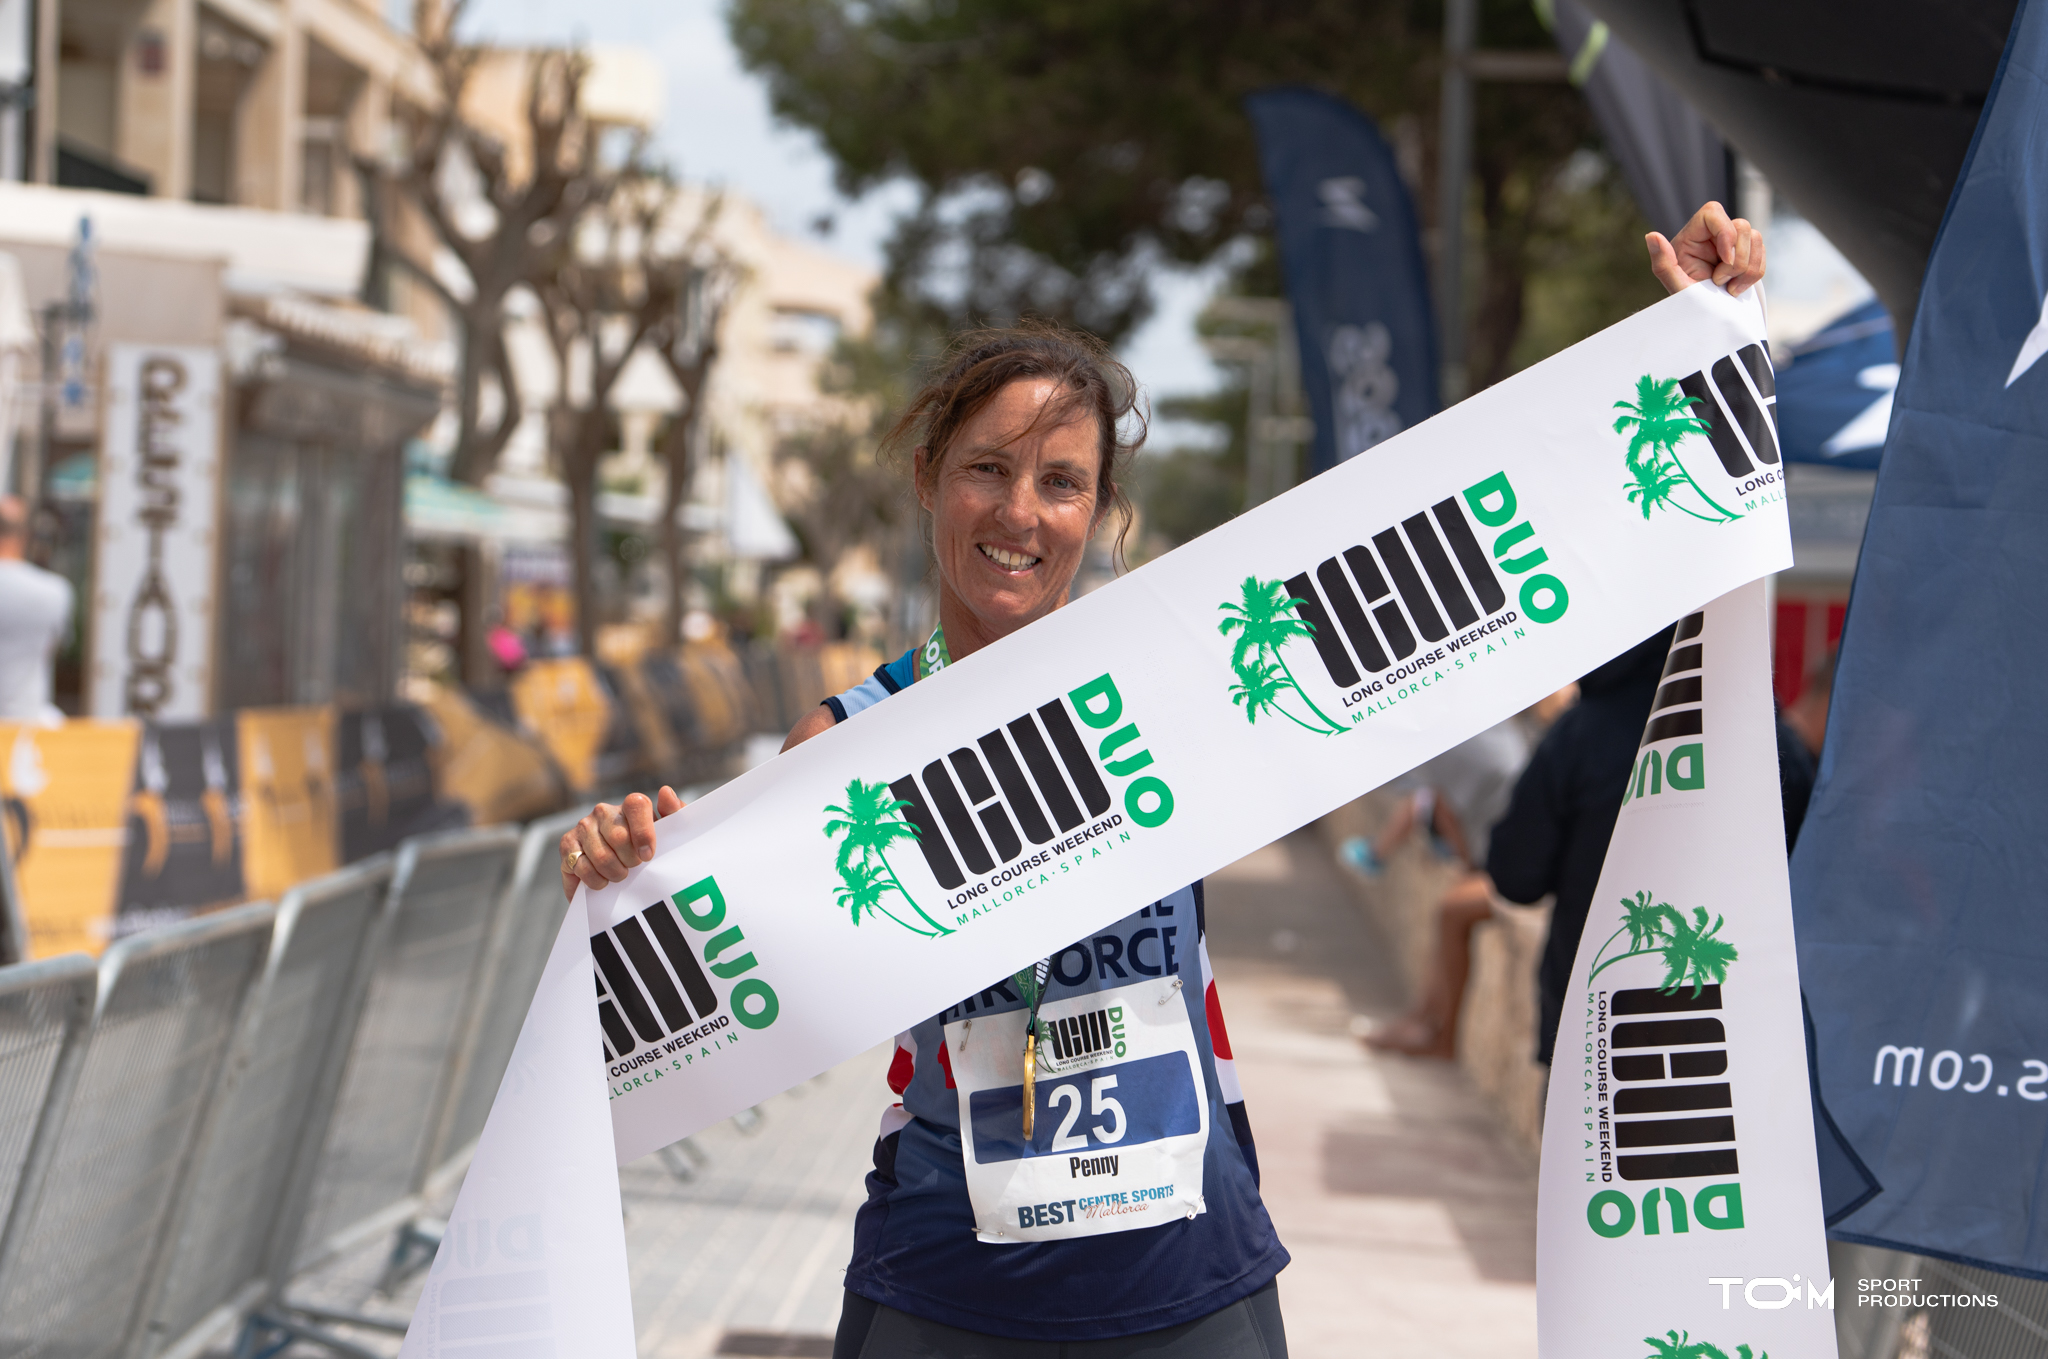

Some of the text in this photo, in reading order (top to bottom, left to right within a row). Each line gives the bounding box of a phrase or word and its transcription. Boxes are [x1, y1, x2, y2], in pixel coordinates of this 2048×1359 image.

[1736, 472, 1775, 496] LONG
[1462, 470, 1569, 624] DUO
[1342, 611, 1518, 708] LONG COURSE WEEKEND
[1067, 672, 1174, 828] DUO
[947, 814, 1123, 910] LONG COURSE WEEKEND
[670, 875, 779, 1030] DUO
[610, 1015, 730, 1077] COURSE WEEKEND
[1070, 1055, 1089, 1064] COURSE
[1090, 1050, 1113, 1059] WEEKEND
[1107, 1006, 1126, 1058] DUO
[1048, 1074, 1127, 1152] 25
[1597, 991, 1613, 1183] LONG COURSE WEEKEND
[1069, 1154, 1119, 1178] Penny
[1017, 1184, 1174, 1229] BEST CENTRE SPORTS
[1084, 1201, 1150, 1219] Mallorca
[1587, 1183, 1745, 1238] DUO
